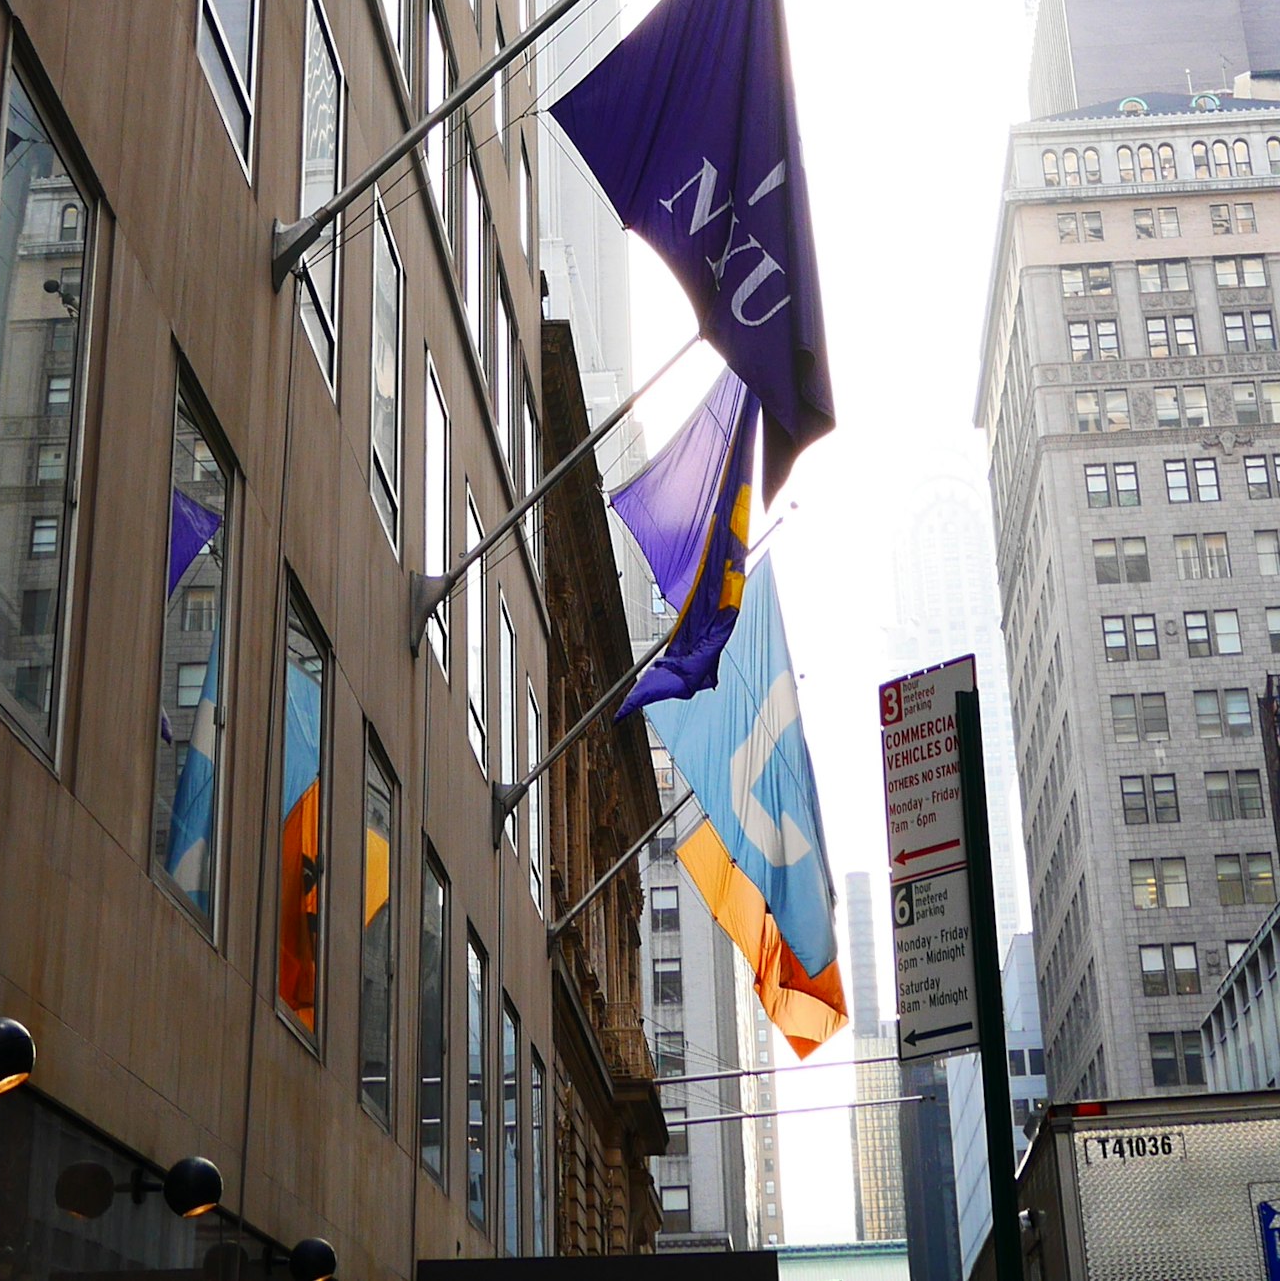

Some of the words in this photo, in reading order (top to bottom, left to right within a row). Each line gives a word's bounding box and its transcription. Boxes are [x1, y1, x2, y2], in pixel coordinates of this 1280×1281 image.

[658, 156, 791, 327] NYU
[903, 679, 919, 691] hour
[903, 684, 935, 703] metered
[884, 687, 899, 722] 3
[904, 700, 932, 718] parking
[886, 714, 955, 750] COMMERCIA
[887, 740, 942, 771] VEHICLES
[945, 734, 960, 752] ON
[888, 773, 920, 794] OTHERS
[922, 769, 933, 783] NO
[889, 797, 923, 816] Monday
[932, 786, 960, 804] Friday
[890, 820, 908, 834] 7am
[916, 811, 937, 828] 6pm
[914, 882, 932, 895] hour
[915, 888, 948, 908] metered
[894, 888, 910, 924] 6
[915, 904, 945, 921] parking
[896, 935, 932, 954] Monday
[940, 925, 969, 943] Friday
[898, 957, 918, 973] 6pm
[926, 942, 965, 965] Midnight
[899, 977, 941, 997] Saturday
[900, 999, 920, 1014] 8am
[929, 986, 968, 1008] Midnight
[1096, 1135, 1172, 1159] T41036
